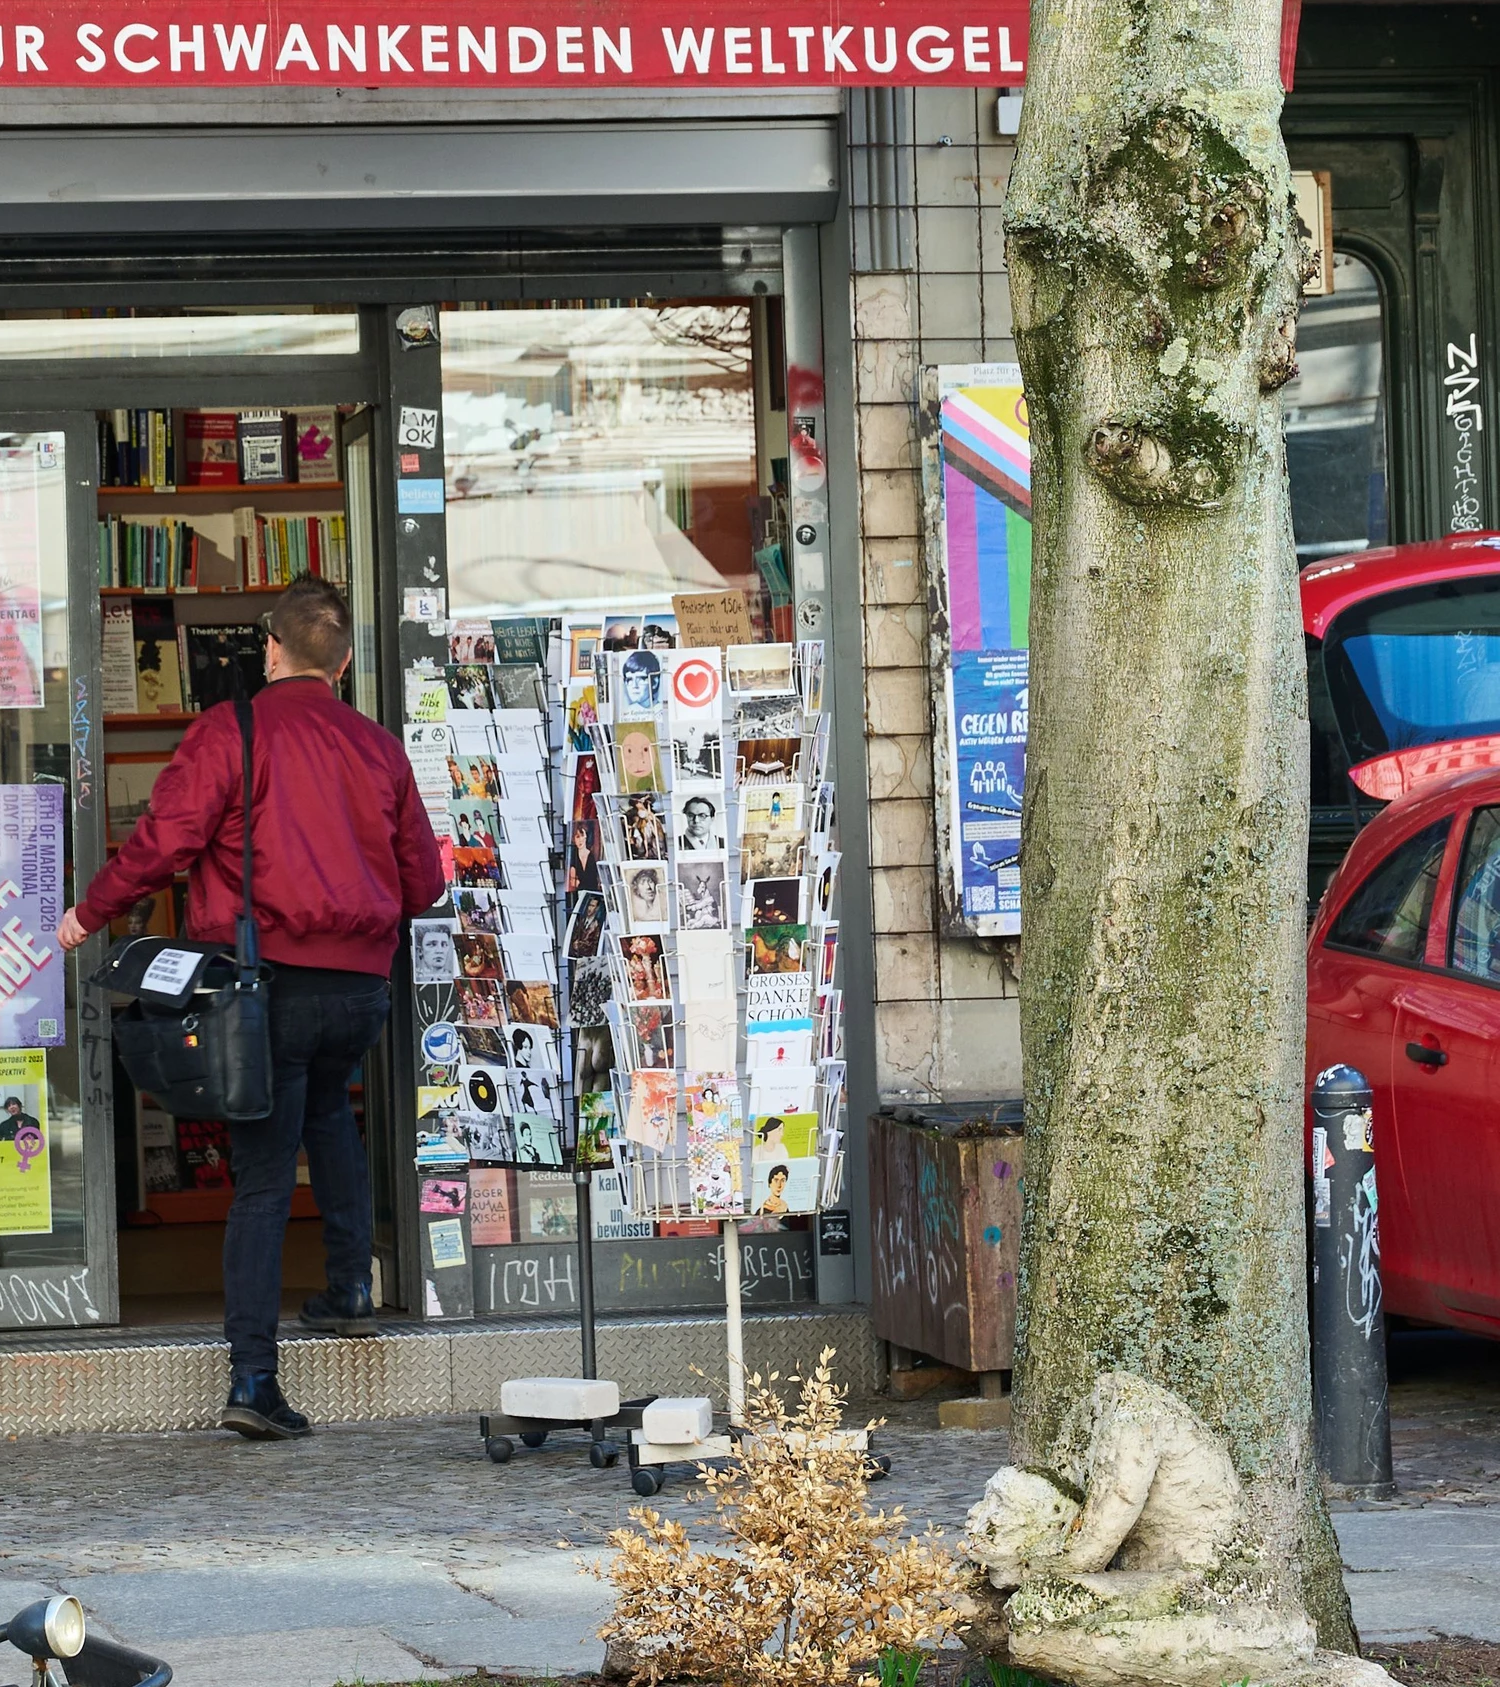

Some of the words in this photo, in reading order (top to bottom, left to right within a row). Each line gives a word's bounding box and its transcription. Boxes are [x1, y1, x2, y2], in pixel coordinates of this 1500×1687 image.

[74, 22, 633, 74] SCHWANKENDEN
[661, 25, 1025, 75] WELTKUGEL
[973, 366, 994, 376] Platz
[997, 367, 1009, 375] für
[406, 428, 433, 444] OK
[401, 488, 441, 500] believe
[679, 597, 716, 615] Postkarten
[190, 626, 220, 635] Theater
[221, 627, 236, 635] der
[237, 626, 254, 635] Zeit
[960, 711, 1008, 736] GEGEN
[959, 737, 978, 746] AKTIV
[978, 735, 1004, 745] WERDEN
[1004, 734, 1027, 744] GEGEN
[4, 793, 19, 819] DAY
[39, 793, 56, 820] 8TH
[4, 823, 19, 840] OF
[39, 823, 56, 841] OF
[21, 793, 38, 899] INTERNATIONAL
[39, 844, 56, 893] MARCH
[39, 896, 57, 932] 2026
[749, 973, 810, 988] GROSSES
[749, 989, 809, 1006] DANKE
[748, 1004, 808, 1022] SCHÖN
[0, 1056, 27, 1064] OKTOBER
[28, 1055, 44, 1063] 2023
[422, 1091, 459, 1109] FAU
[529, 1171, 573, 1181] Redeku
[472, 1188, 503, 1198] GGER
[471, 1213, 506, 1224] XISCH
[597, 1222, 651, 1238] bewusste
